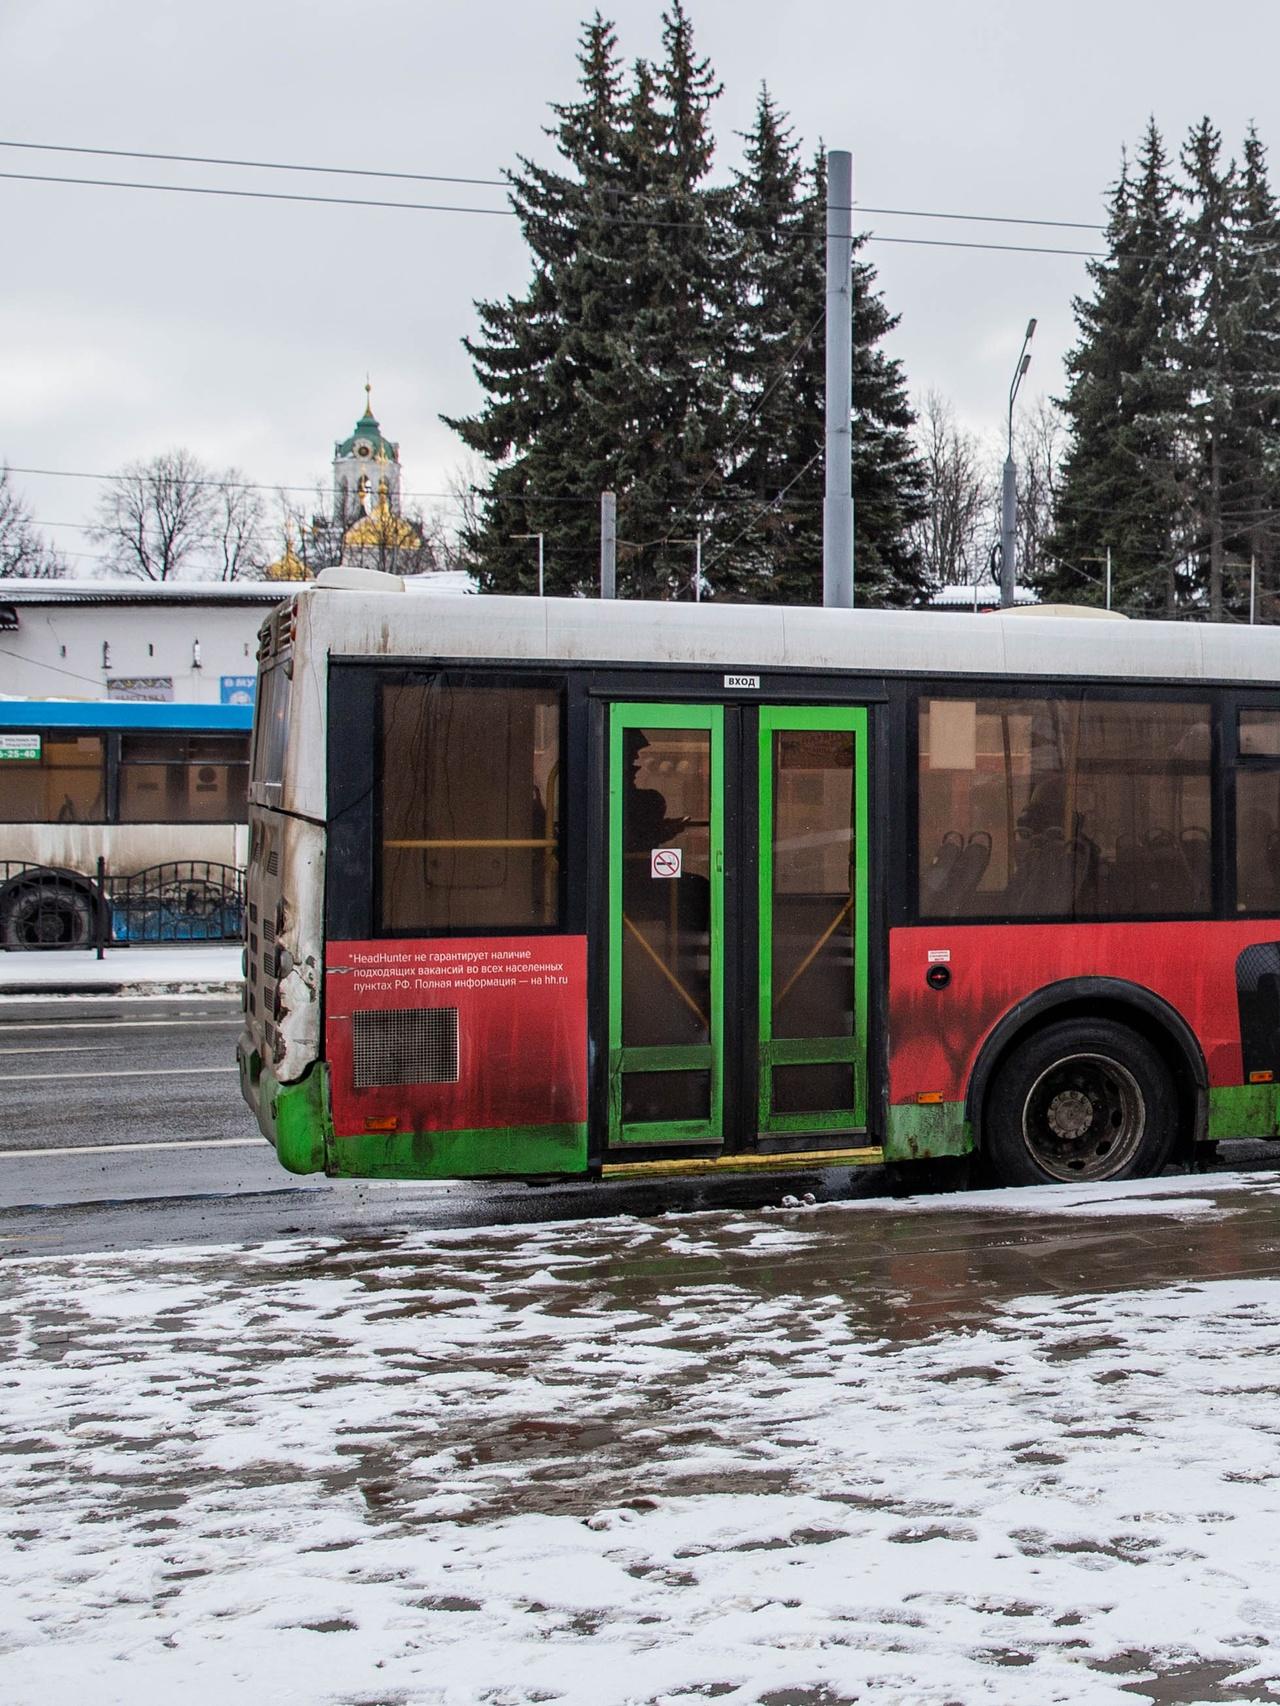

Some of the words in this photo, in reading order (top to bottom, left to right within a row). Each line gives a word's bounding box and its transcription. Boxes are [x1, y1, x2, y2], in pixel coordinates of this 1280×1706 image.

[728, 677, 756, 688] ВХОД
[414, 953, 427, 962] не
[429, 951, 489, 963] гарантирует
[491, 950, 532, 960] наличие
[353, 967, 416, 978] подходящих
[418, 964, 464, 975] вакансий
[466, 965, 479, 974] во
[481, 964, 504, 974] всех
[505, 963, 564, 973] населенных
[353, 982, 393, 993] пунктах
[395, 979, 412, 989] РФ.
[415, 979, 452, 989] Полная
[454, 977, 517, 990] информация
[531, 976, 542, 985] на
[544, 975, 568, 985] hh.ru
